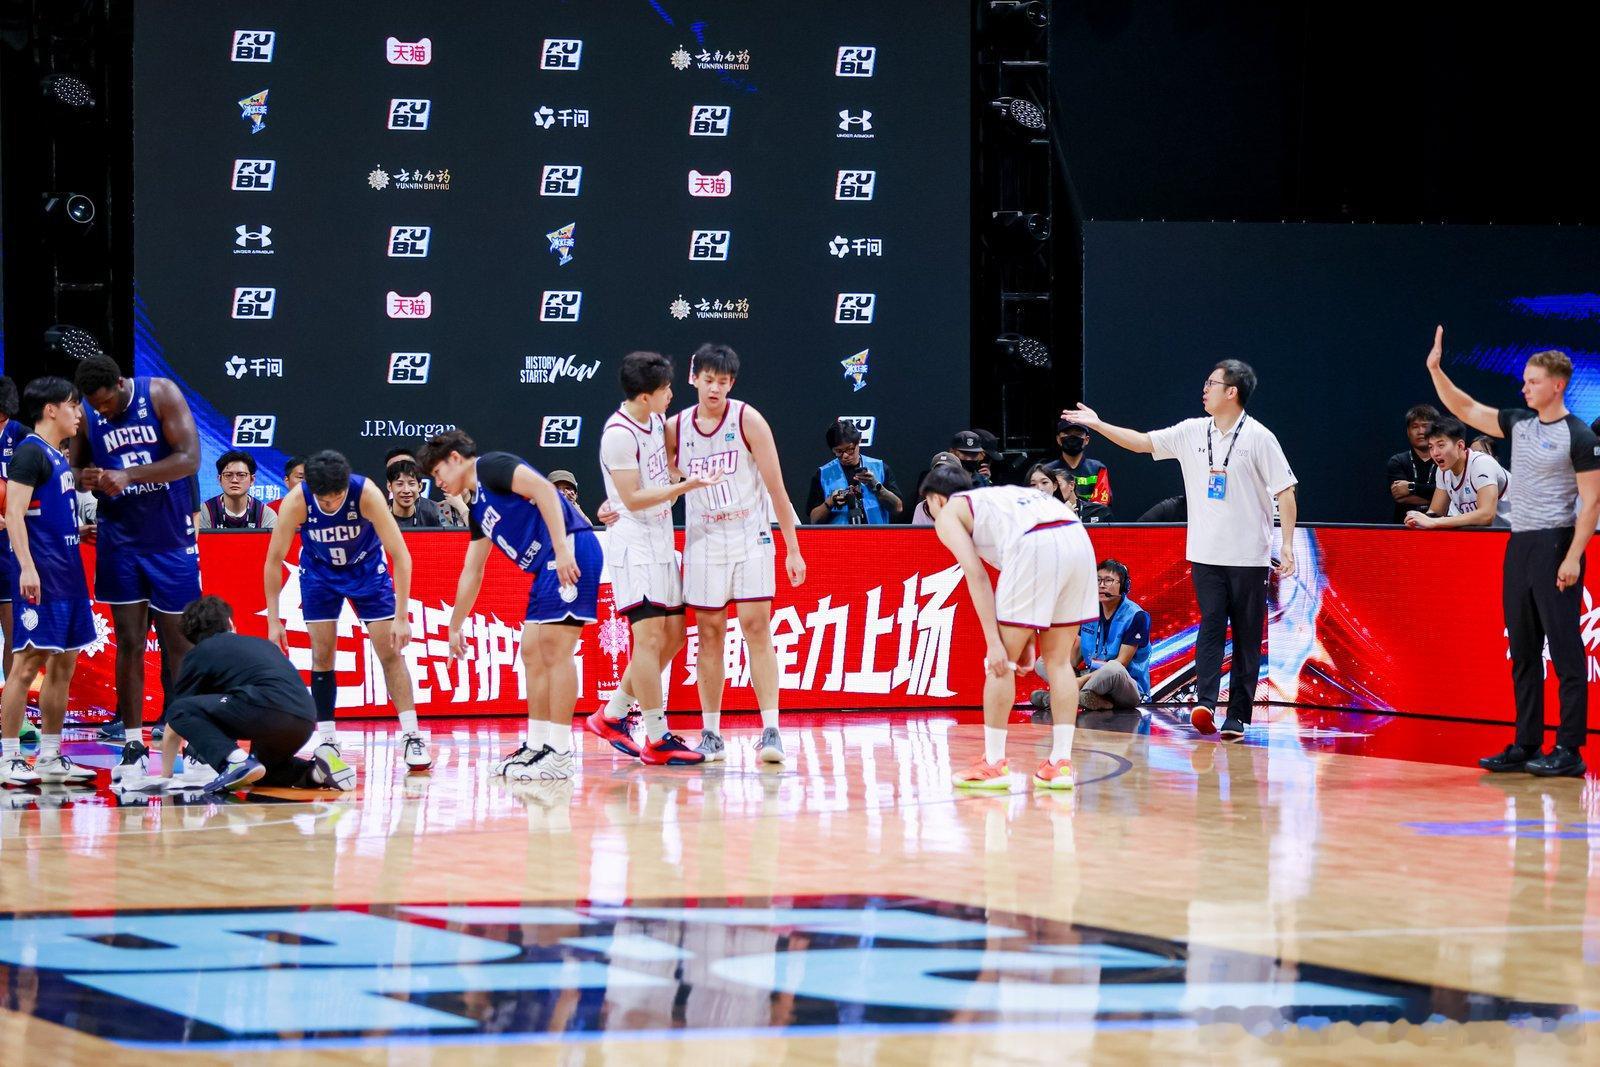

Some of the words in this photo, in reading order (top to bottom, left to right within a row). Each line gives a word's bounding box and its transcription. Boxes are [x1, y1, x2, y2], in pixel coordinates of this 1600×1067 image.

[394, 45, 425, 62] 天猫
[695, 49, 750, 63] 云南白药
[557, 108, 589, 127] 千问
[393, 168, 451, 183] 云南白药
[695, 178, 725, 193] 天猫
[852, 238, 882, 257] 千问
[394, 299, 425, 315] 天猫
[694, 297, 750, 312] 云南白药
[250, 358, 282, 377] 千问
[525, 356, 556, 369] HISTORY
[520, 370, 548, 383] STARTS
[103, 425, 158, 453] NCCU
[706, 480, 733, 511] 10
[308, 525, 360, 543] NCCU
[329, 547, 347, 566] 9
[682, 562, 965, 698] 全力上场
